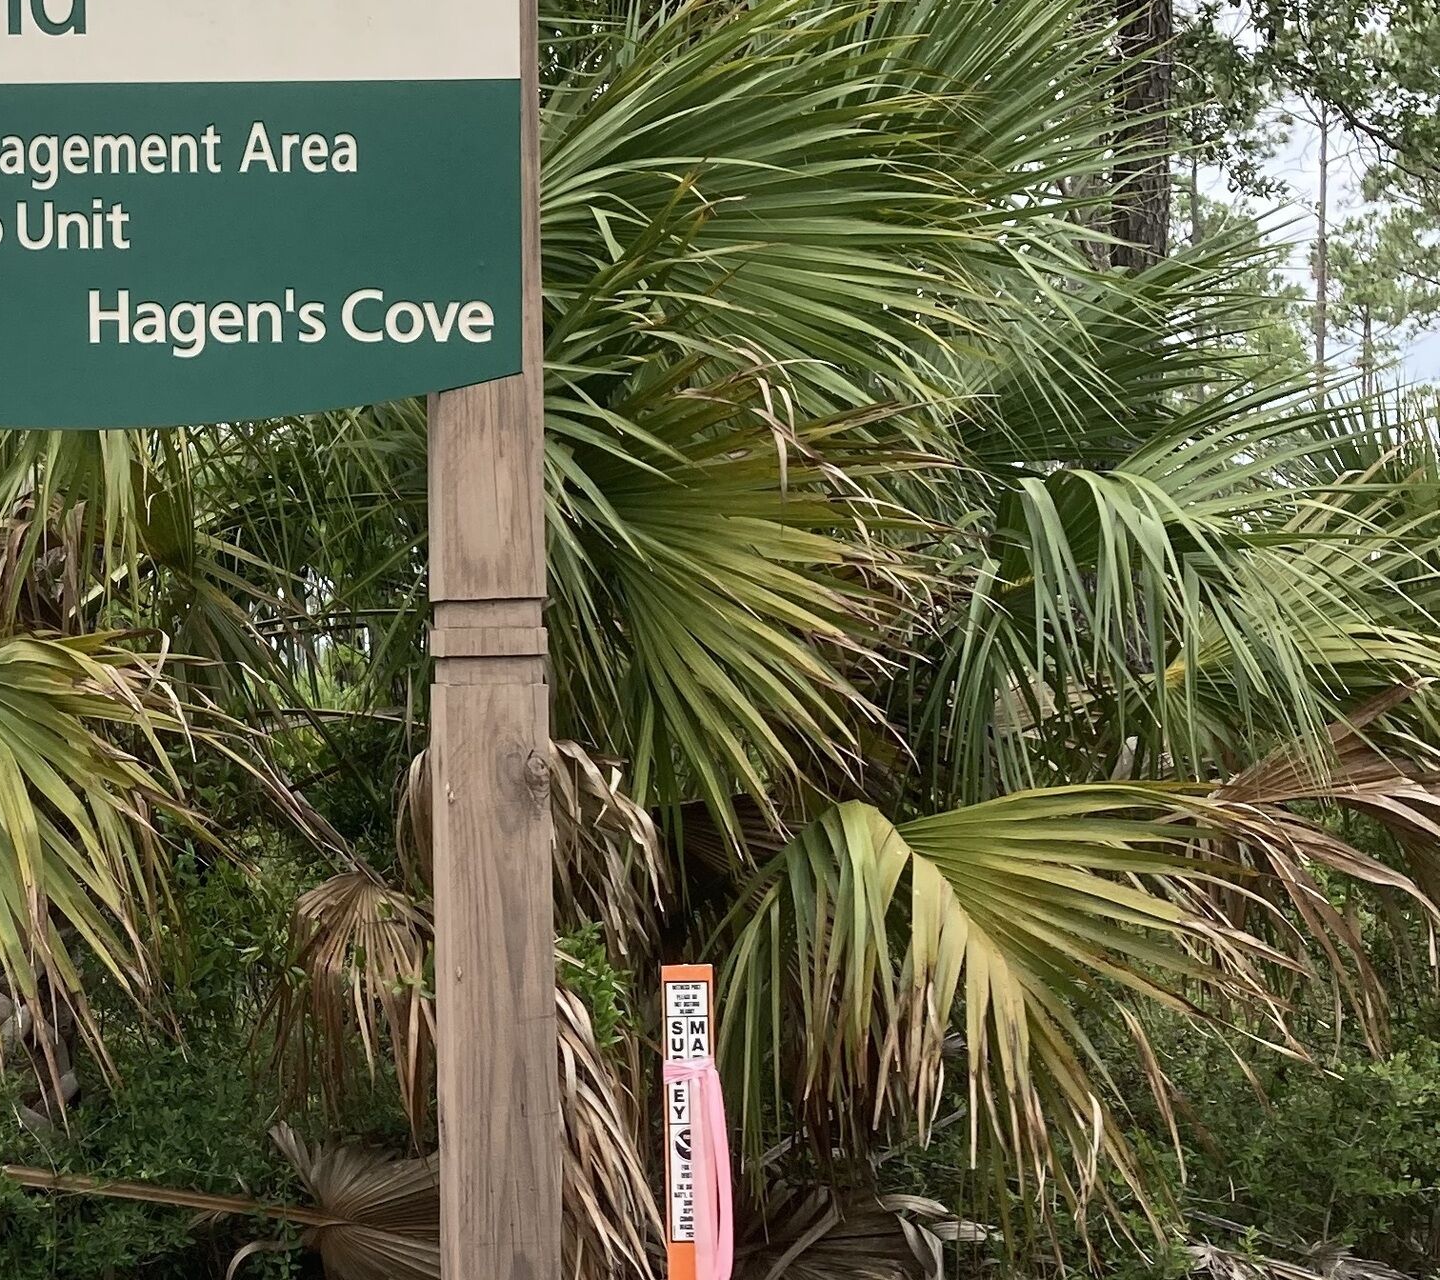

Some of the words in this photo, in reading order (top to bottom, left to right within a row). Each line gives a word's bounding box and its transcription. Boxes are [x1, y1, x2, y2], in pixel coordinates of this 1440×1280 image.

[240, 122, 359, 173] Area
[16, 198, 131, 250] Unit
[89, 289, 327, 358] Hagen's
[341, 289, 495, 344] Cove
[671, 1021, 686, 1120] SUEY
